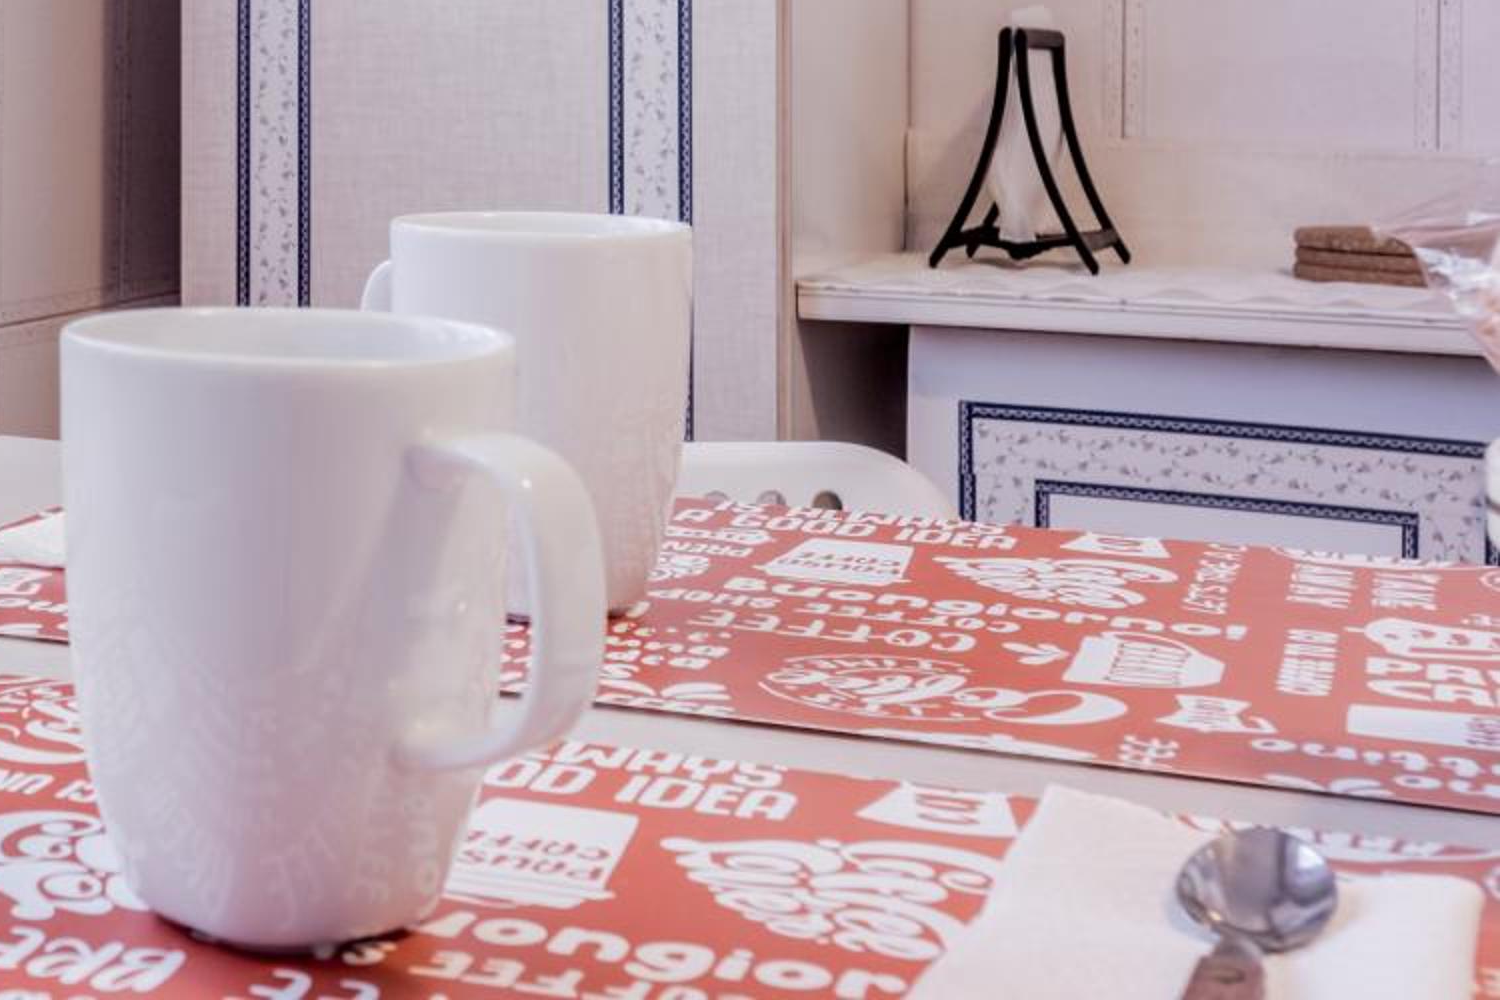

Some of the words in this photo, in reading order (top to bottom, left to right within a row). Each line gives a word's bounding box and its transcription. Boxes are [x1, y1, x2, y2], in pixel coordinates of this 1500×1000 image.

[673, 508, 715, 522] A
[730, 513, 877, 537] GOOD
[894, 527, 1018, 549] IDEA
[784, 505, 1007, 535] ALWAYS
[662, 541, 753, 558] PREN
[647, 588, 782, 609] SHOP
[723, 577, 1248, 640] Buongiorno!
[793, 602, 1022, 634] COFFEE
[687, 608, 977, 653] COFFEE
[766, 670, 1128, 726] Coffee
[526, 741, 788, 789] WAYS
[614, 773, 798, 822] IDEA
